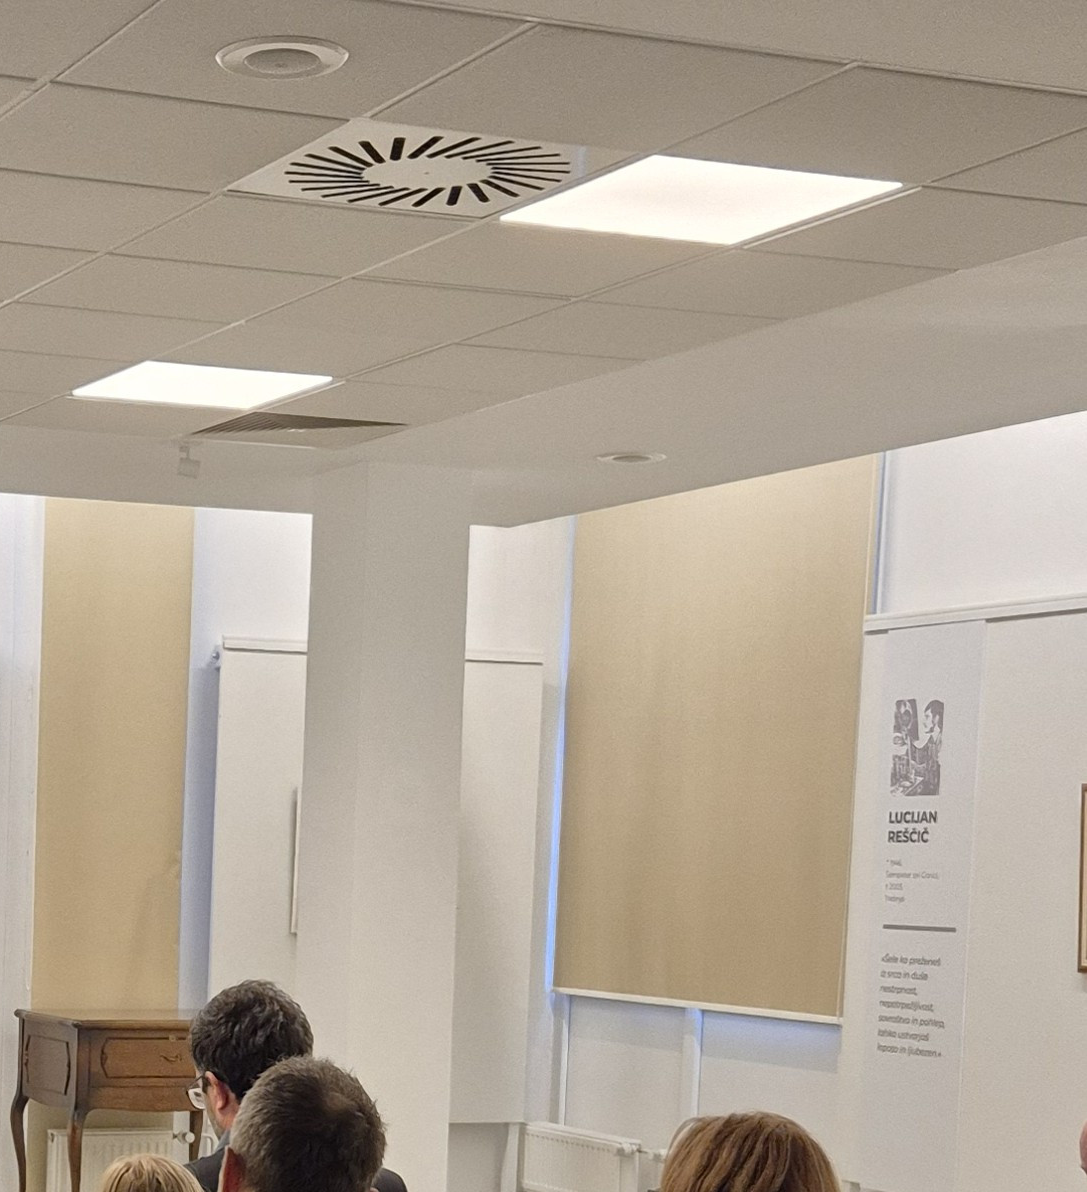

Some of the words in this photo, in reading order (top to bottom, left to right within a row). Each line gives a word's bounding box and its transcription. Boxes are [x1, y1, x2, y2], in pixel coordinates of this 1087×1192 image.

[888, 810, 938, 824] LUCIJAN
[887, 827, 930, 843] REŠČIČ
[902, 971, 910, 979] in
[911, 1016, 919, 1024] in
[899, 1045, 907, 1053] in
